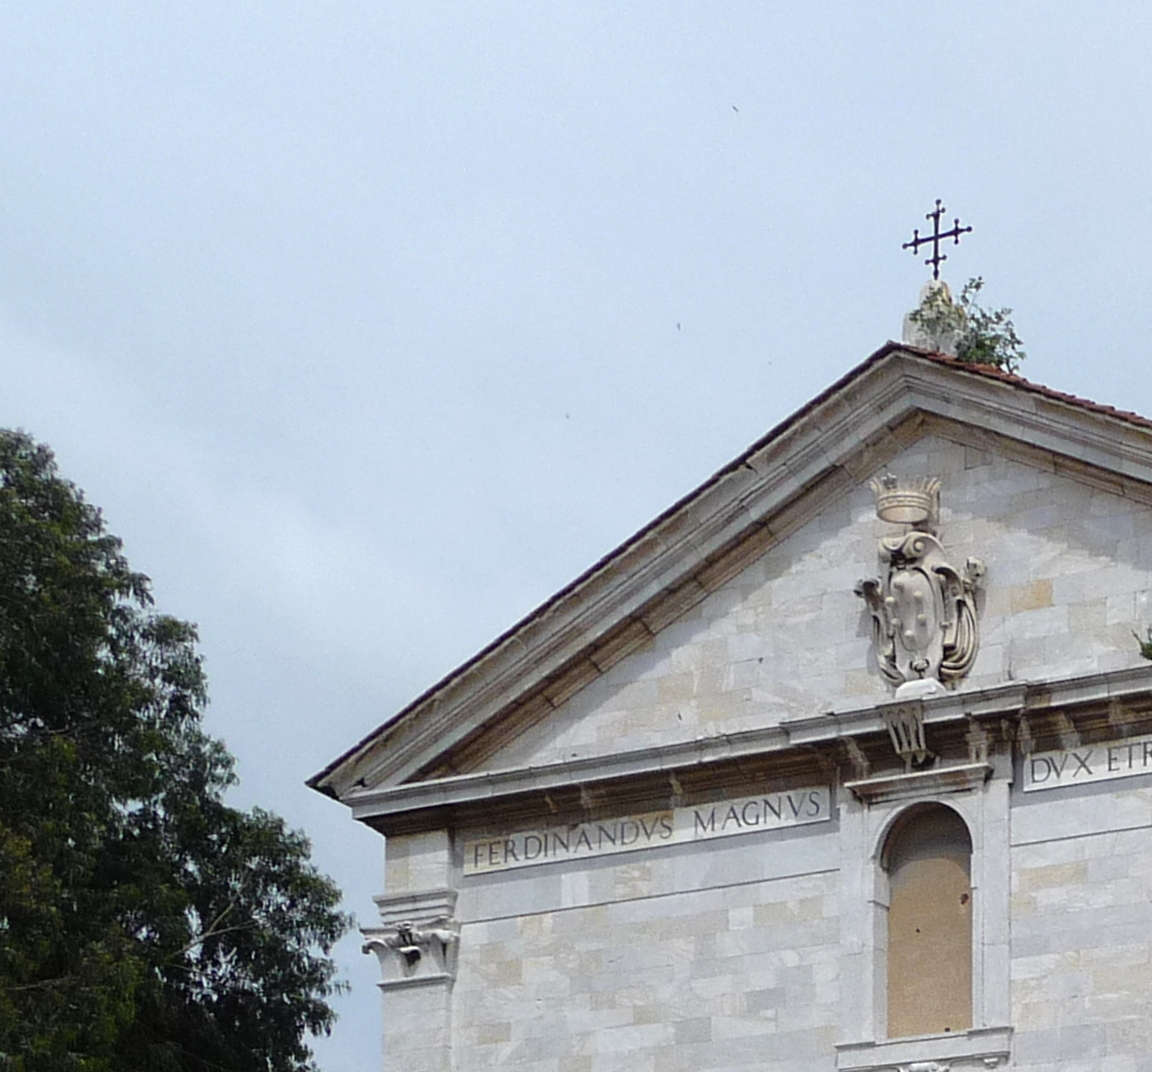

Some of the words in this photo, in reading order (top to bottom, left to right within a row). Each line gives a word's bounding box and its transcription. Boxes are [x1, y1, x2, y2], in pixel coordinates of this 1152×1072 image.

[1030, 751, 1093, 783] DVX
[474, 815, 673, 868] FERDINANDVS
[693, 791, 820, 836] MAGNVS
